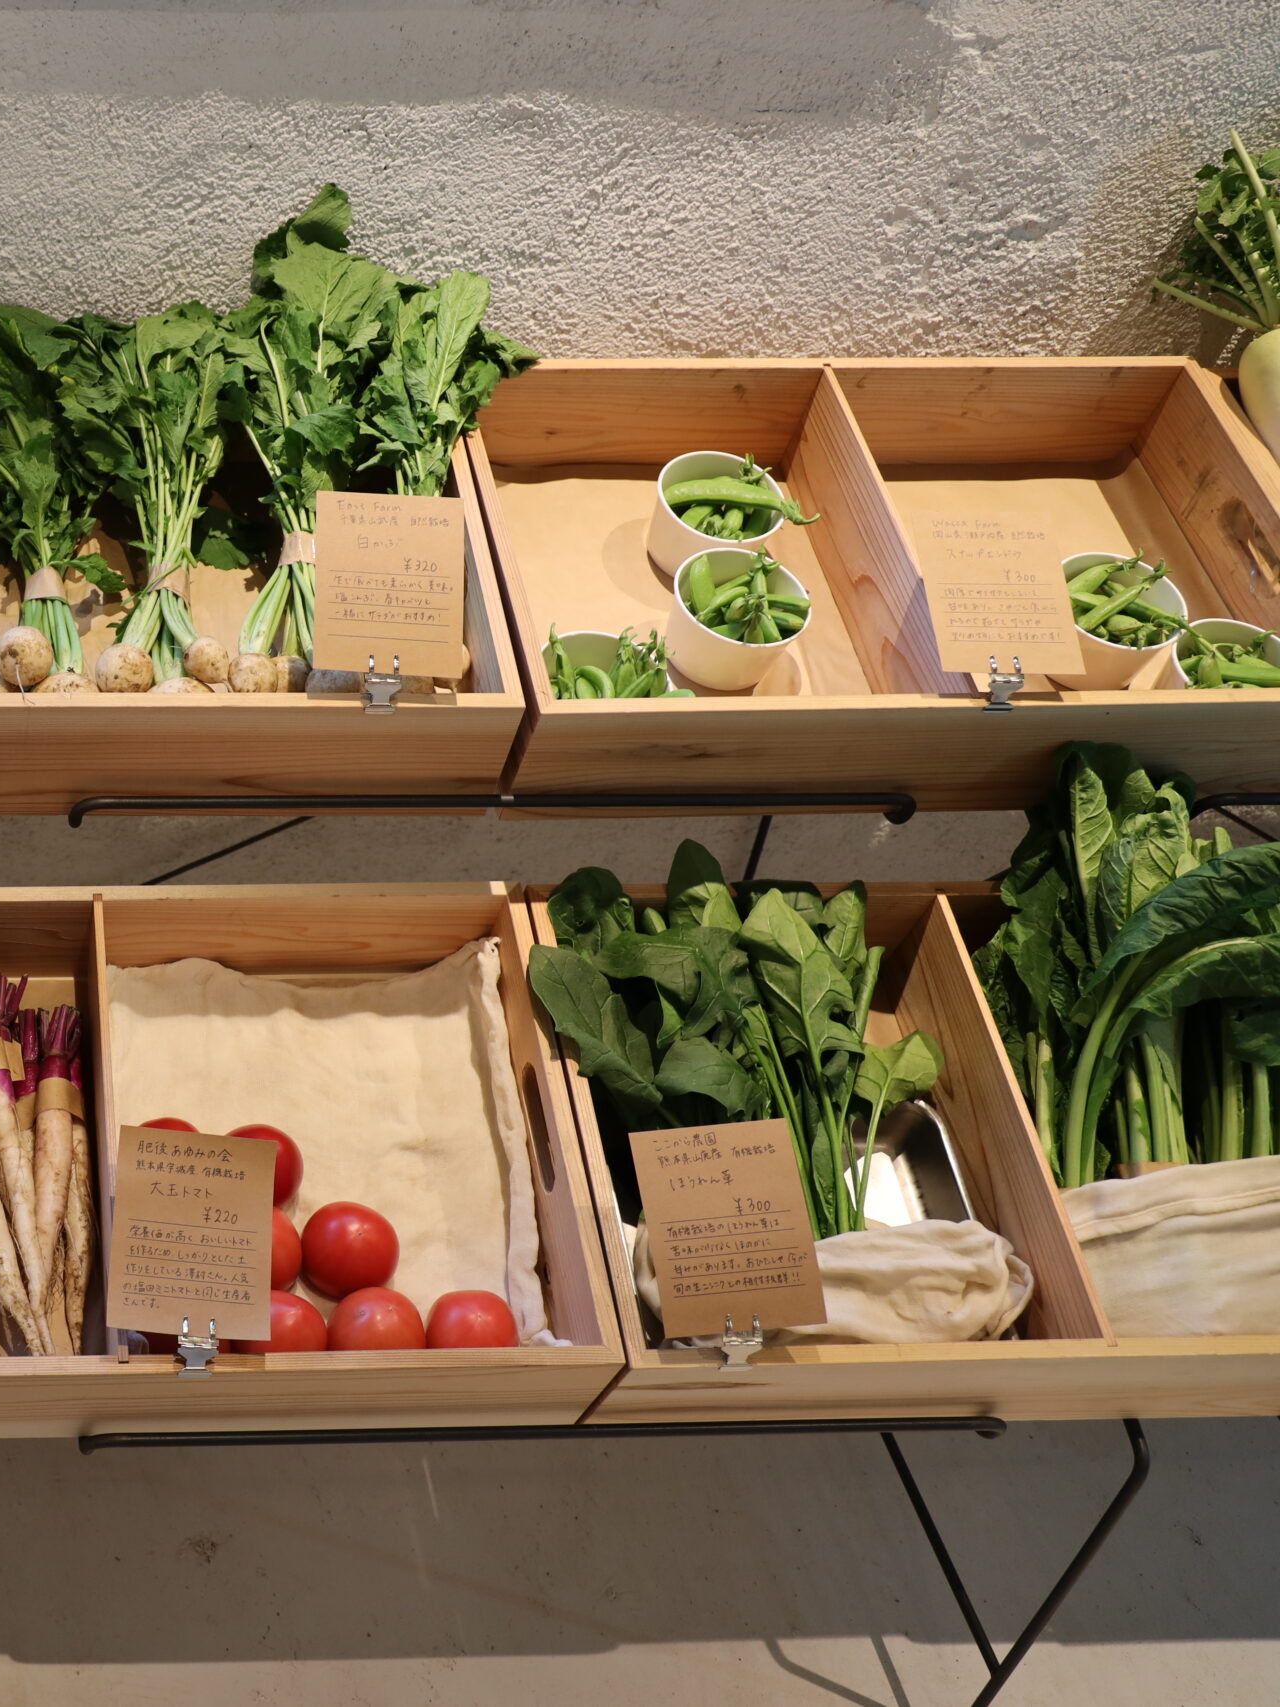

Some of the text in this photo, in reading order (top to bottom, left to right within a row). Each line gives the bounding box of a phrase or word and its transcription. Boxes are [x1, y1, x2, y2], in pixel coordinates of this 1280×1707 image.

[403, 557, 439, 573] ¥320
[137, 1139, 234, 1164] 肥後あゆみの会
[149, 1181, 214, 1200] 大玉トマト
[202, 1206, 239, 1225] ¥220
[732, 1196, 772, 1217] ¥300
